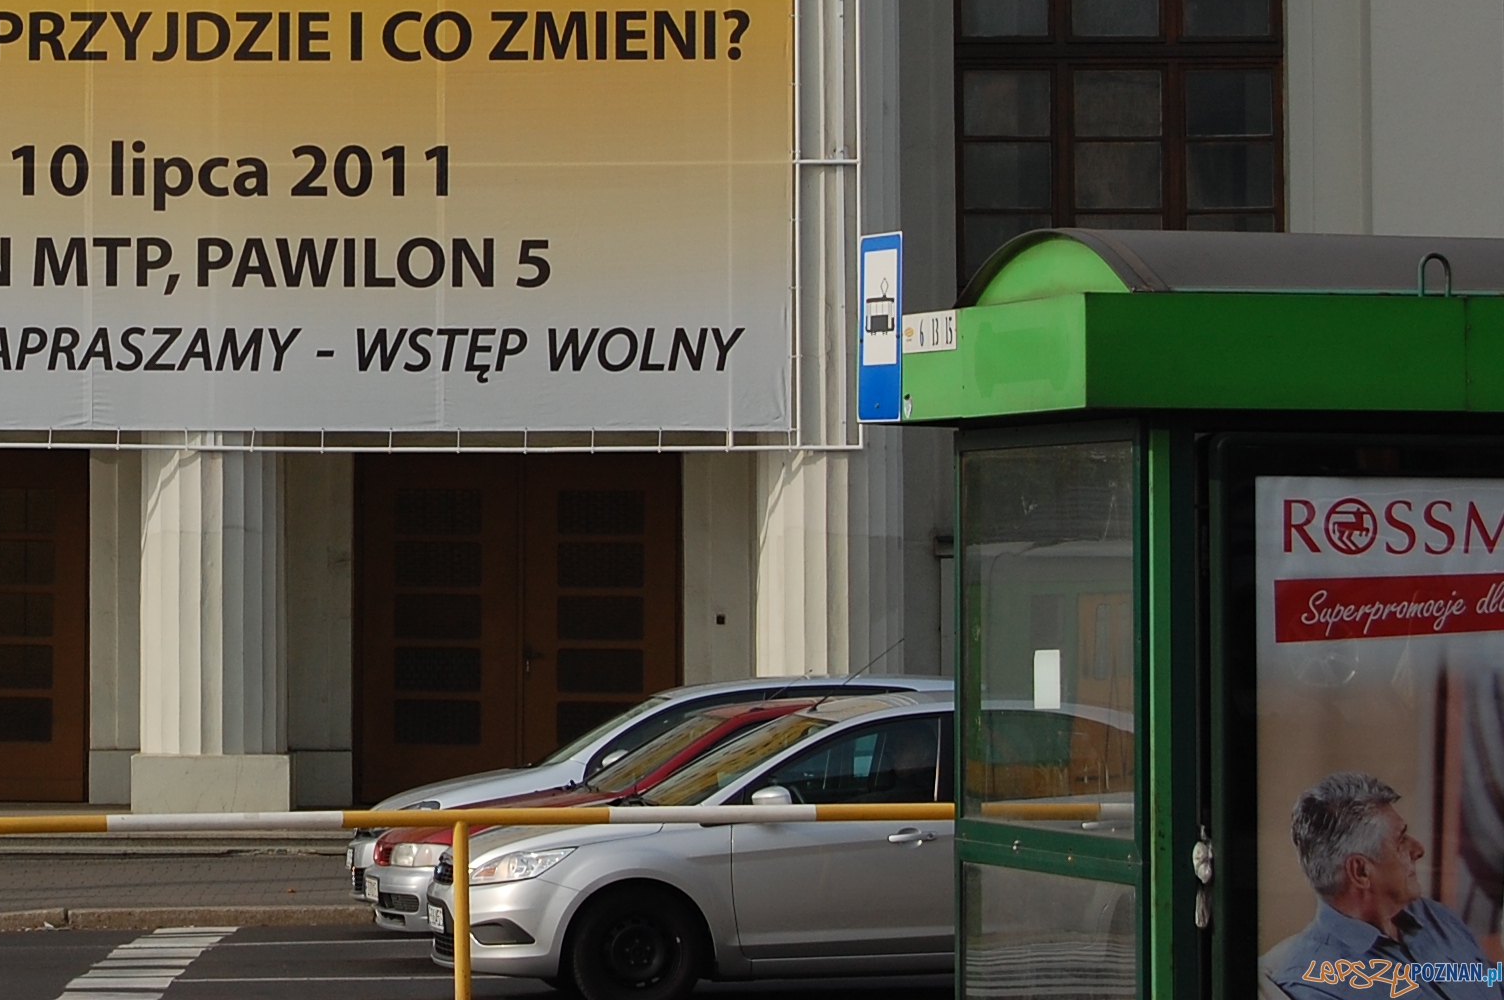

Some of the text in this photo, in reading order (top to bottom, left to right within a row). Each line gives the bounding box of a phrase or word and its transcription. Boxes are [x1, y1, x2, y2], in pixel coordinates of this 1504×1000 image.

[350, 11, 363, 61] I
[382, 10, 472, 62] CO
[488, 9, 750, 61] ZMIENI?
[11, 144, 89, 197] 10
[111, 140, 269, 212] lipca
[290, 144, 451, 197] 2011
[33, 237, 180, 295] MTP,
[197, 237, 495, 288] PAWILON
[516, 239, 551, 288] 5
[316, 350, 335, 358] -
[356, 327, 528, 384] WSTĘP
[548, 327, 746, 372] WOLNY
[919, 316, 953, 347] 6 13 15
[1301, 590, 1467, 637] Superpromocje
